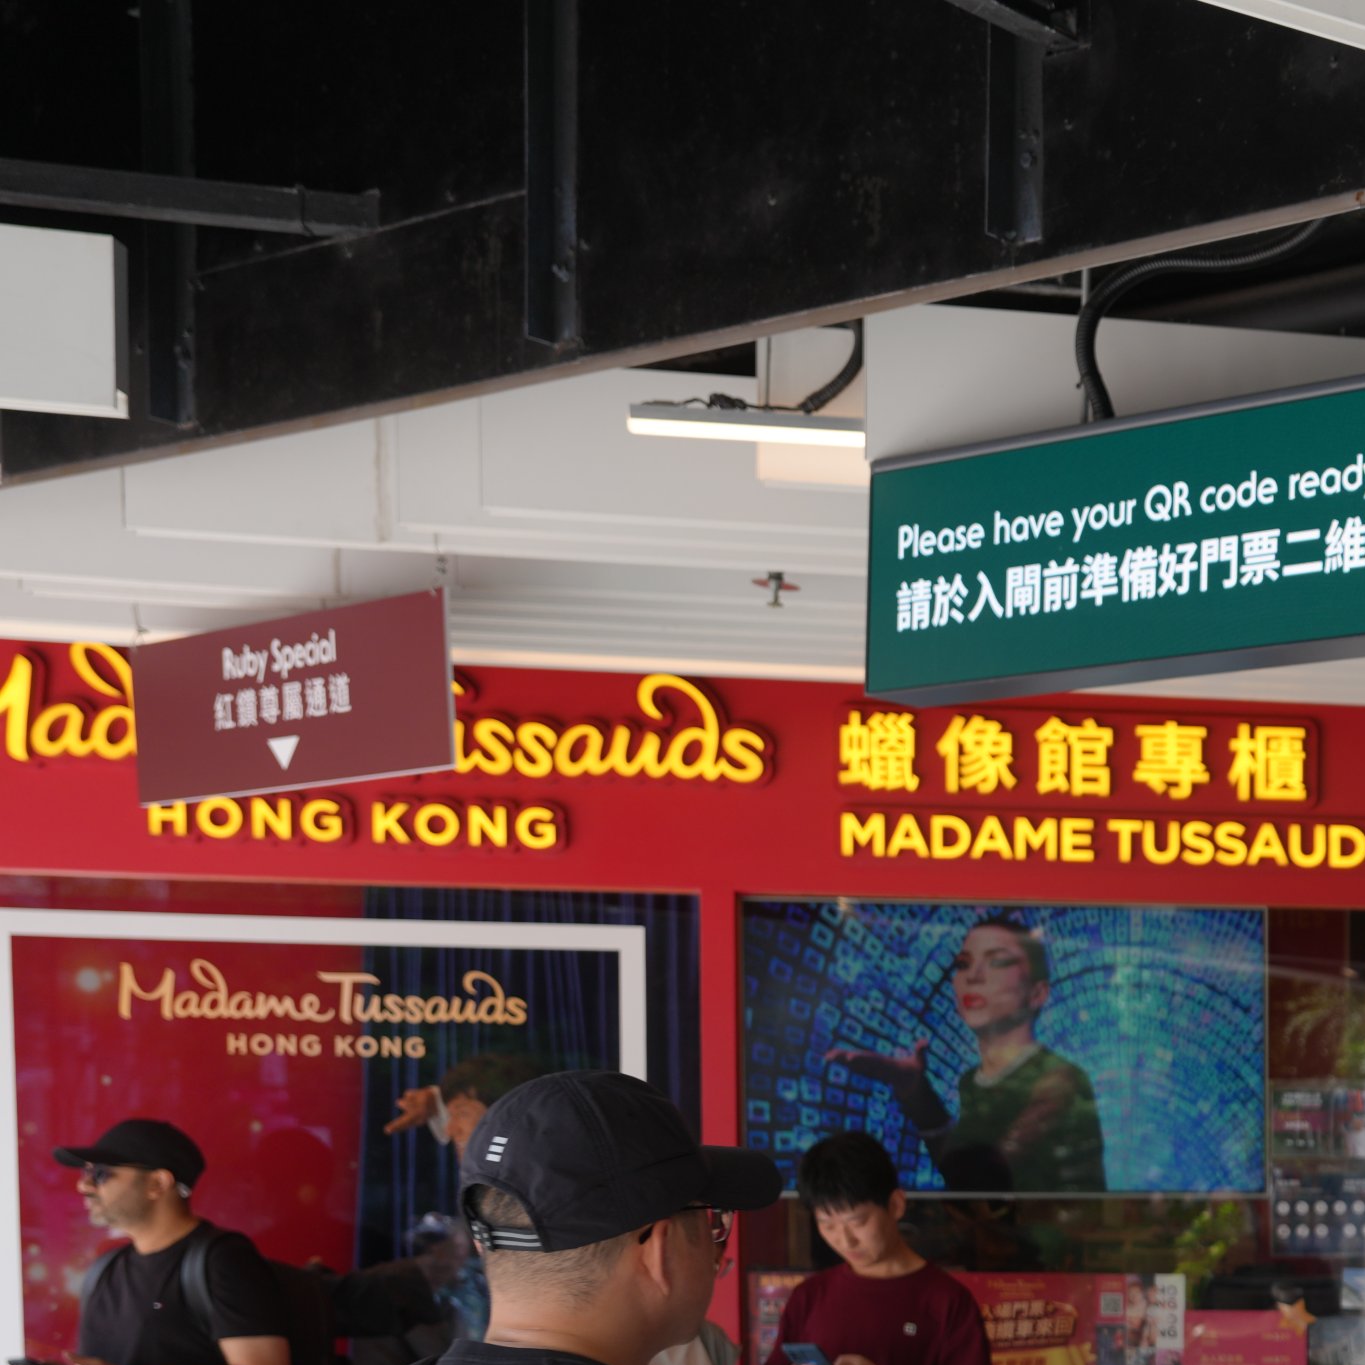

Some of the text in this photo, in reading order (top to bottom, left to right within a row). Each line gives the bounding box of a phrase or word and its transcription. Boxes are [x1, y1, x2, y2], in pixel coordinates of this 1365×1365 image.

[898, 523, 985, 560] Please
[993, 511, 1065, 545] have
[1072, 498, 1137, 543] your
[1144, 483, 1193, 522] QR
[1199, 471, 1279, 512] code
[221, 628, 338, 684] Ruby Special
[838, 710, 1307, 801] 蠟像館專櫃
[147, 797, 557, 850] HONG KONG
[840, 812, 1095, 862] MADAME
[118, 958, 527, 1025] Madame Tussauds
[226, 1033, 427, 1058] HONG KONG
